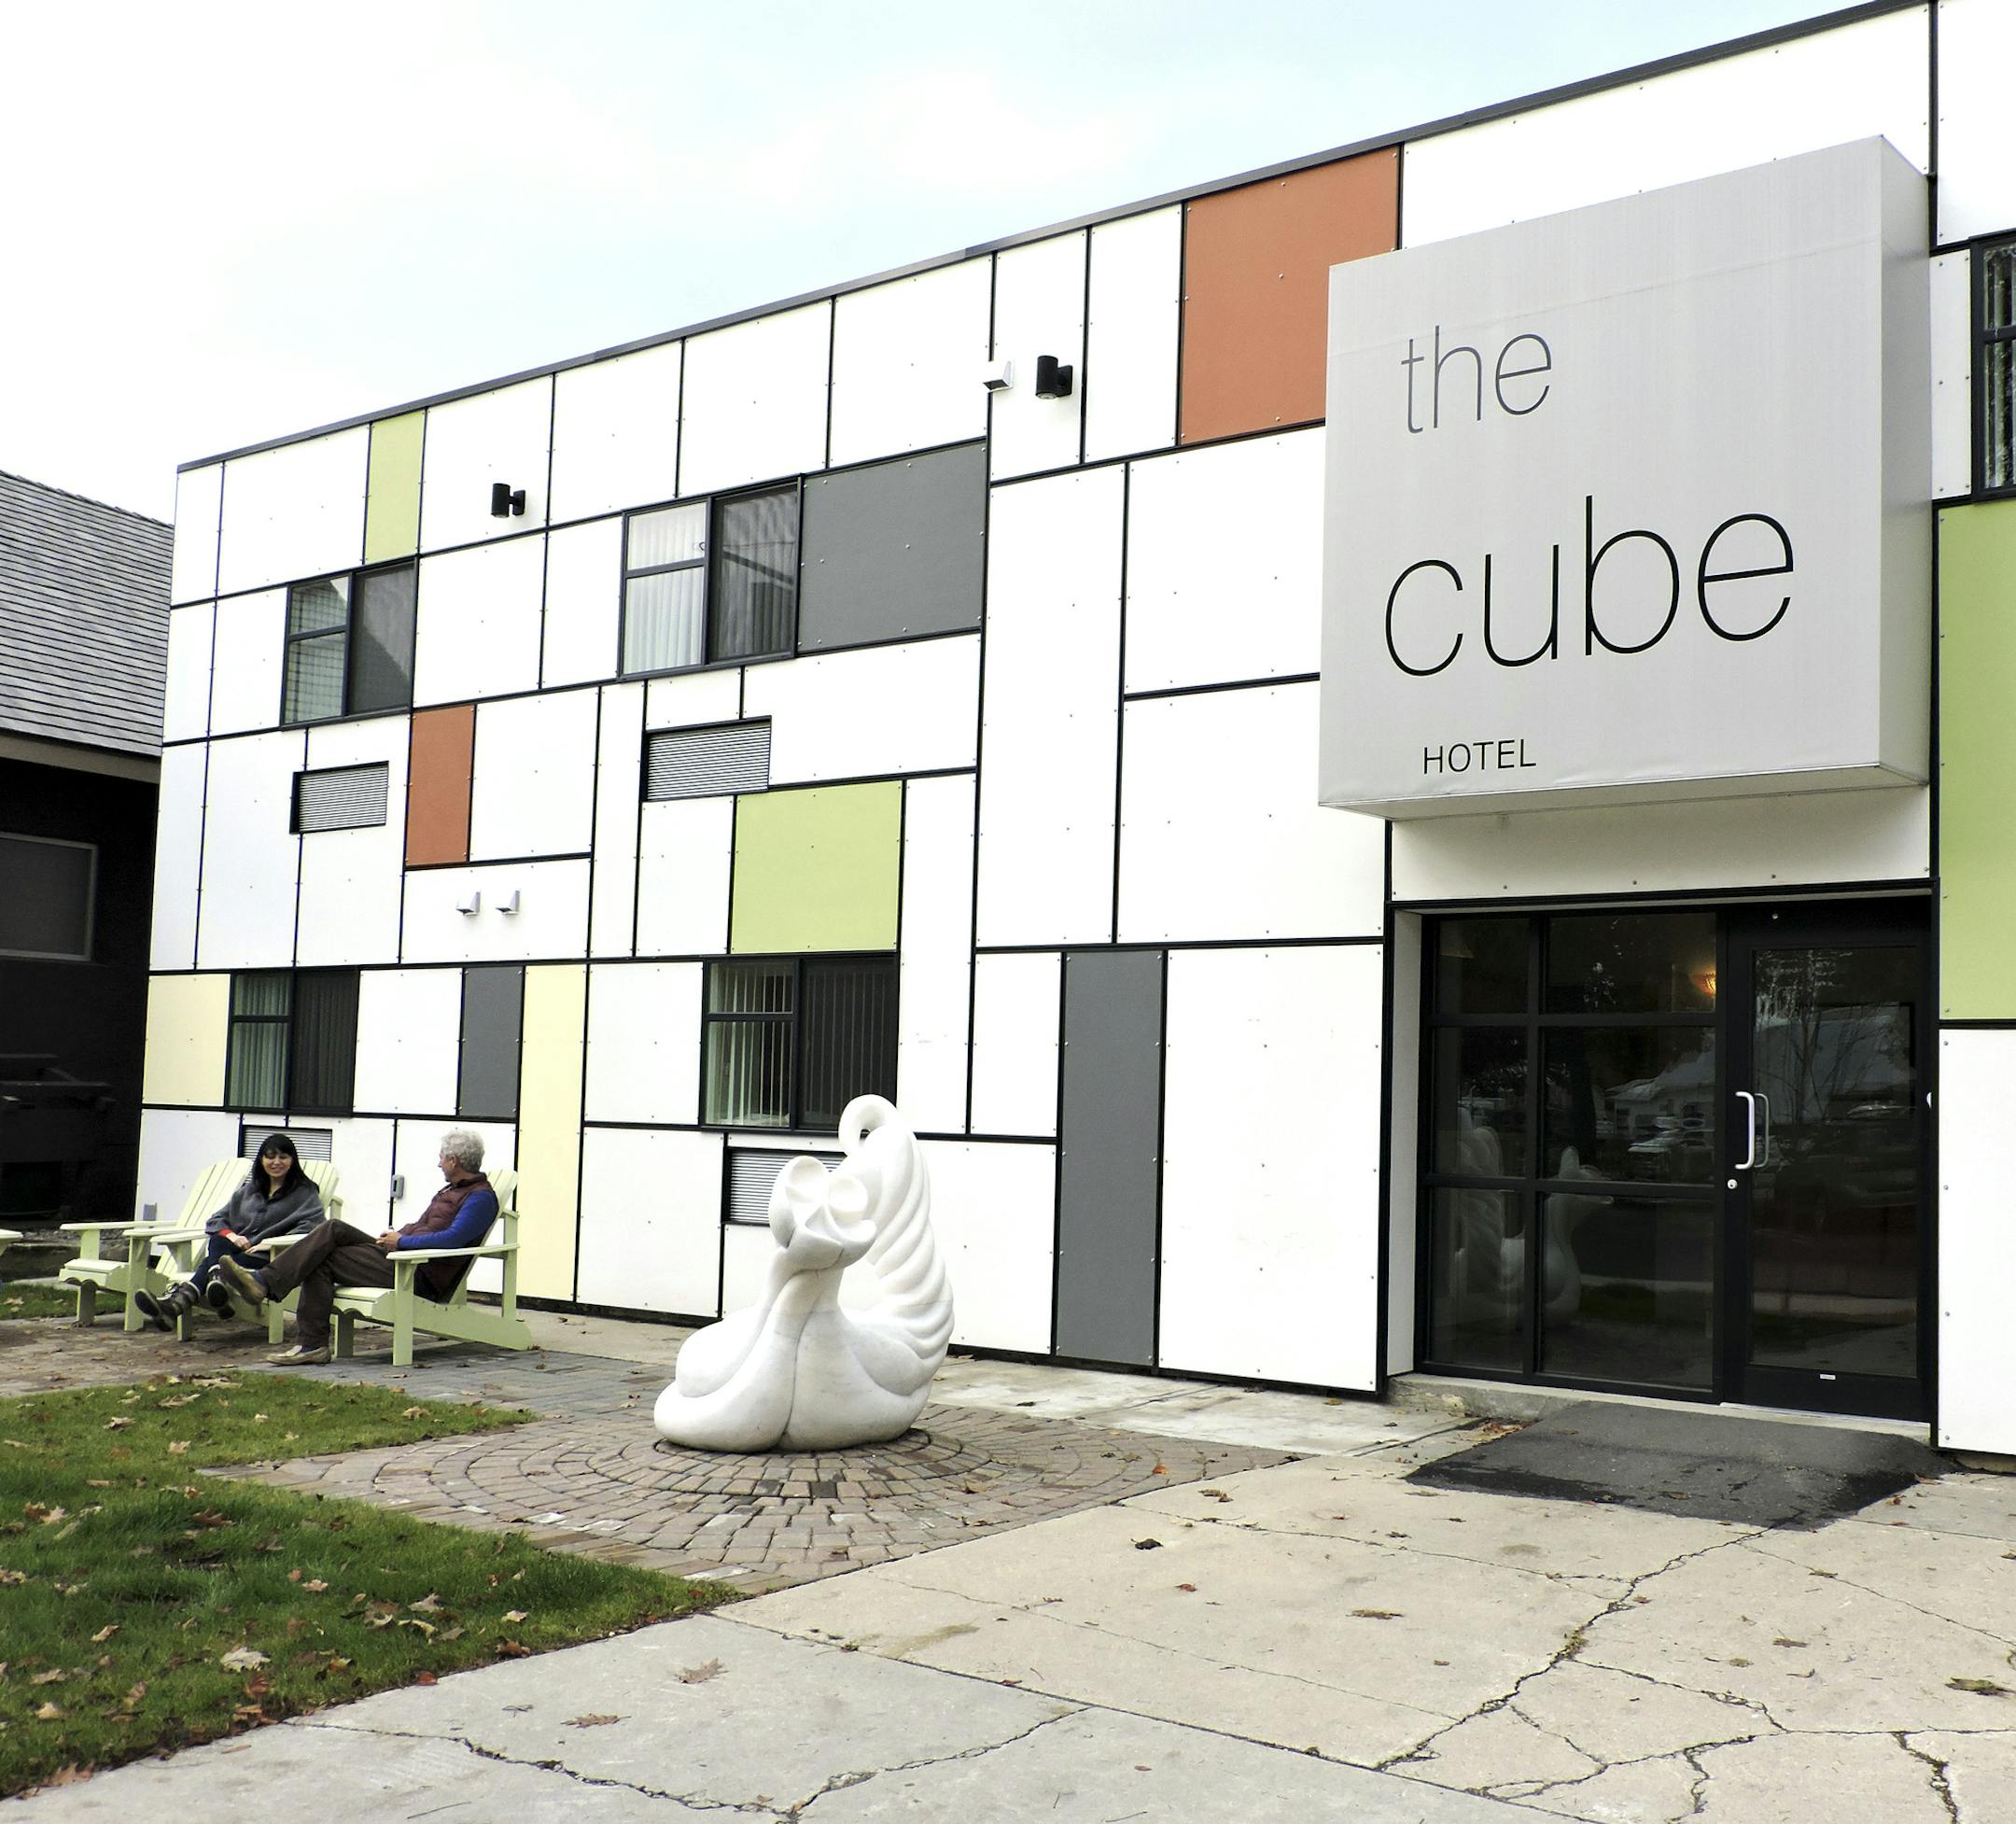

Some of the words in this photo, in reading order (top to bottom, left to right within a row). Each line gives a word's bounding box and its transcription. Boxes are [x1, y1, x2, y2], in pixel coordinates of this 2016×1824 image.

[1400, 325, 1552, 433] the
[1385, 495, 1794, 677] cube
[1423, 738, 1537, 775] HOTEL
